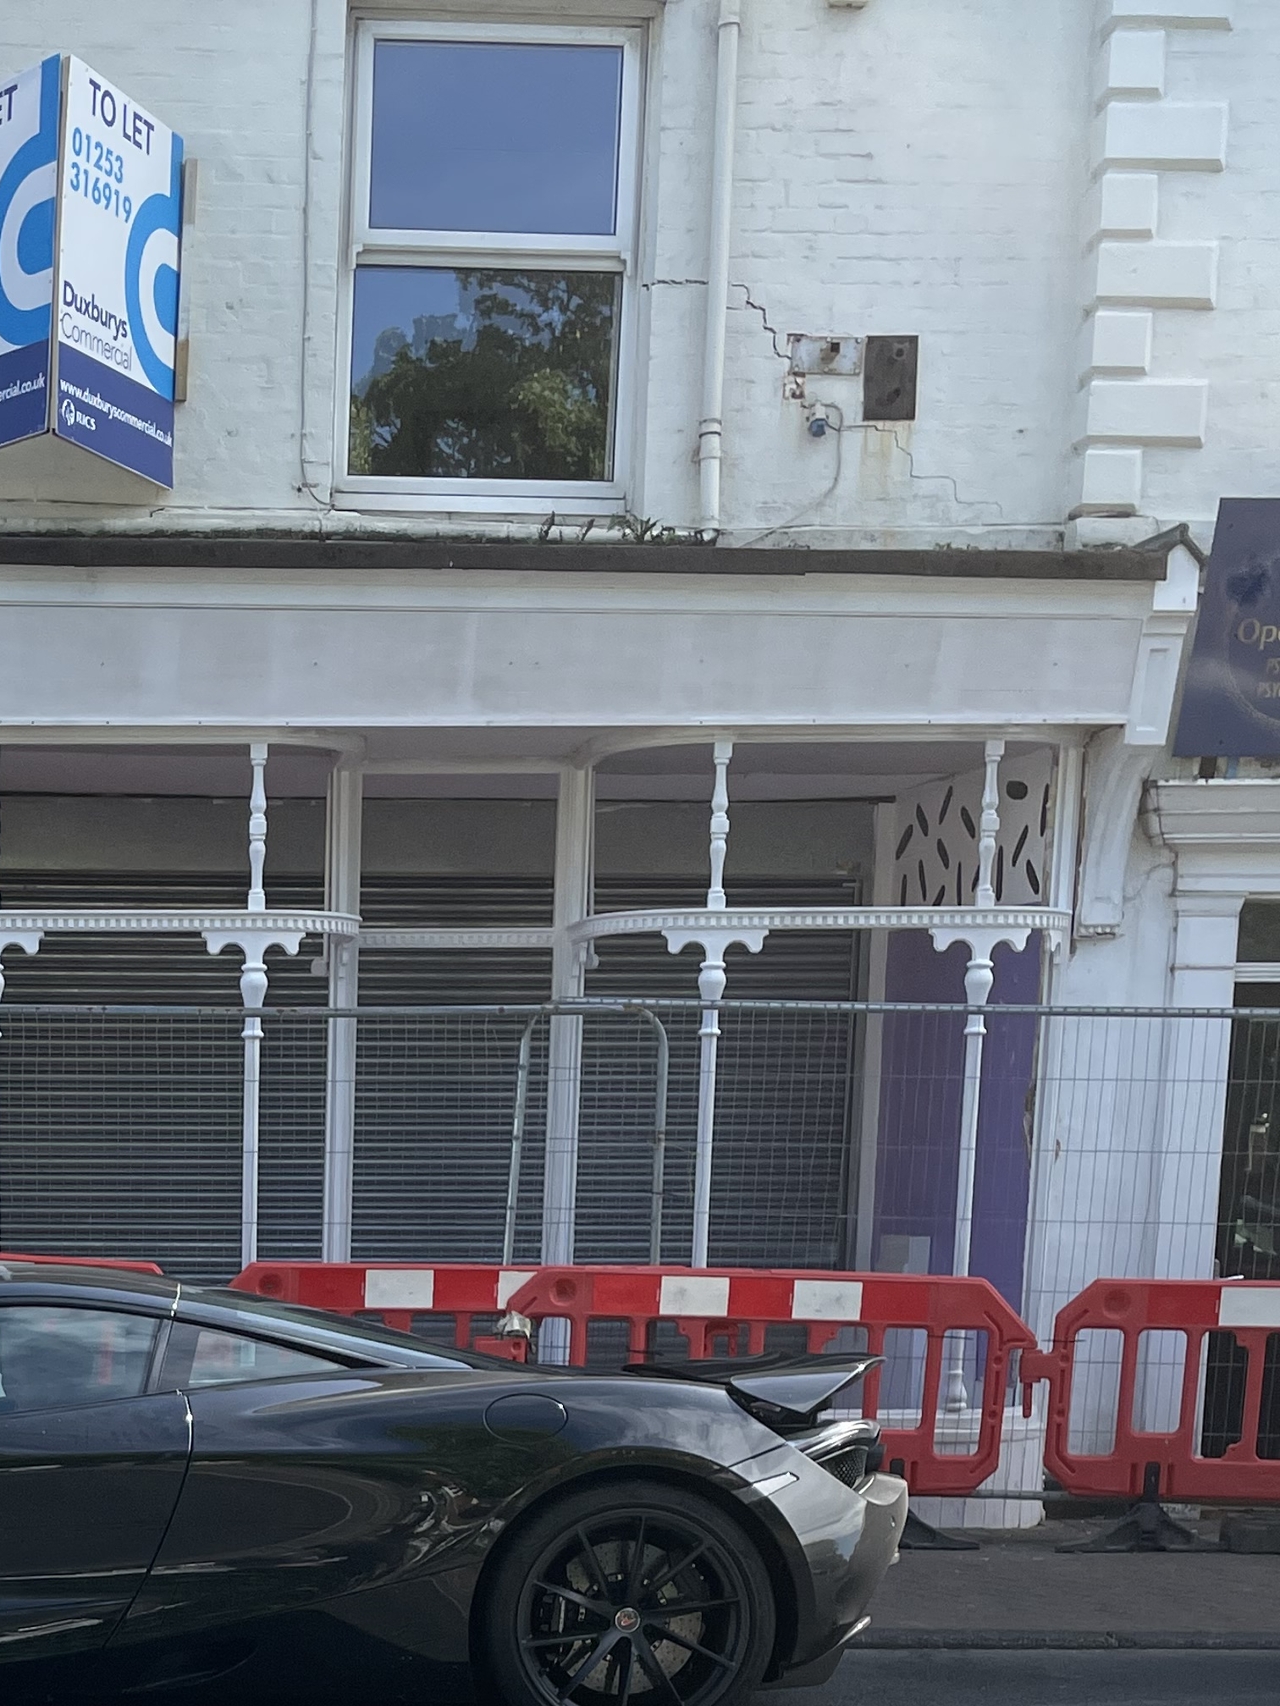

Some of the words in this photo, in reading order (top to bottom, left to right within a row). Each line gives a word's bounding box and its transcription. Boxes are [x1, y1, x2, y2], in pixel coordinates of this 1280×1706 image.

[89, 77, 116, 128] TO
[122, 103, 154, 155] LET
[72, 126, 123, 184] 01253
[70, 161, 132, 224] 316919
[63, 280, 128, 342] Duxburys
[61, 312, 132, 371] Commercial
[60, 379, 173, 448] www.duxburyscommercial.co.uk
[76, 410, 96, 431] RICS
[1237, 618, 1280, 651] Op
